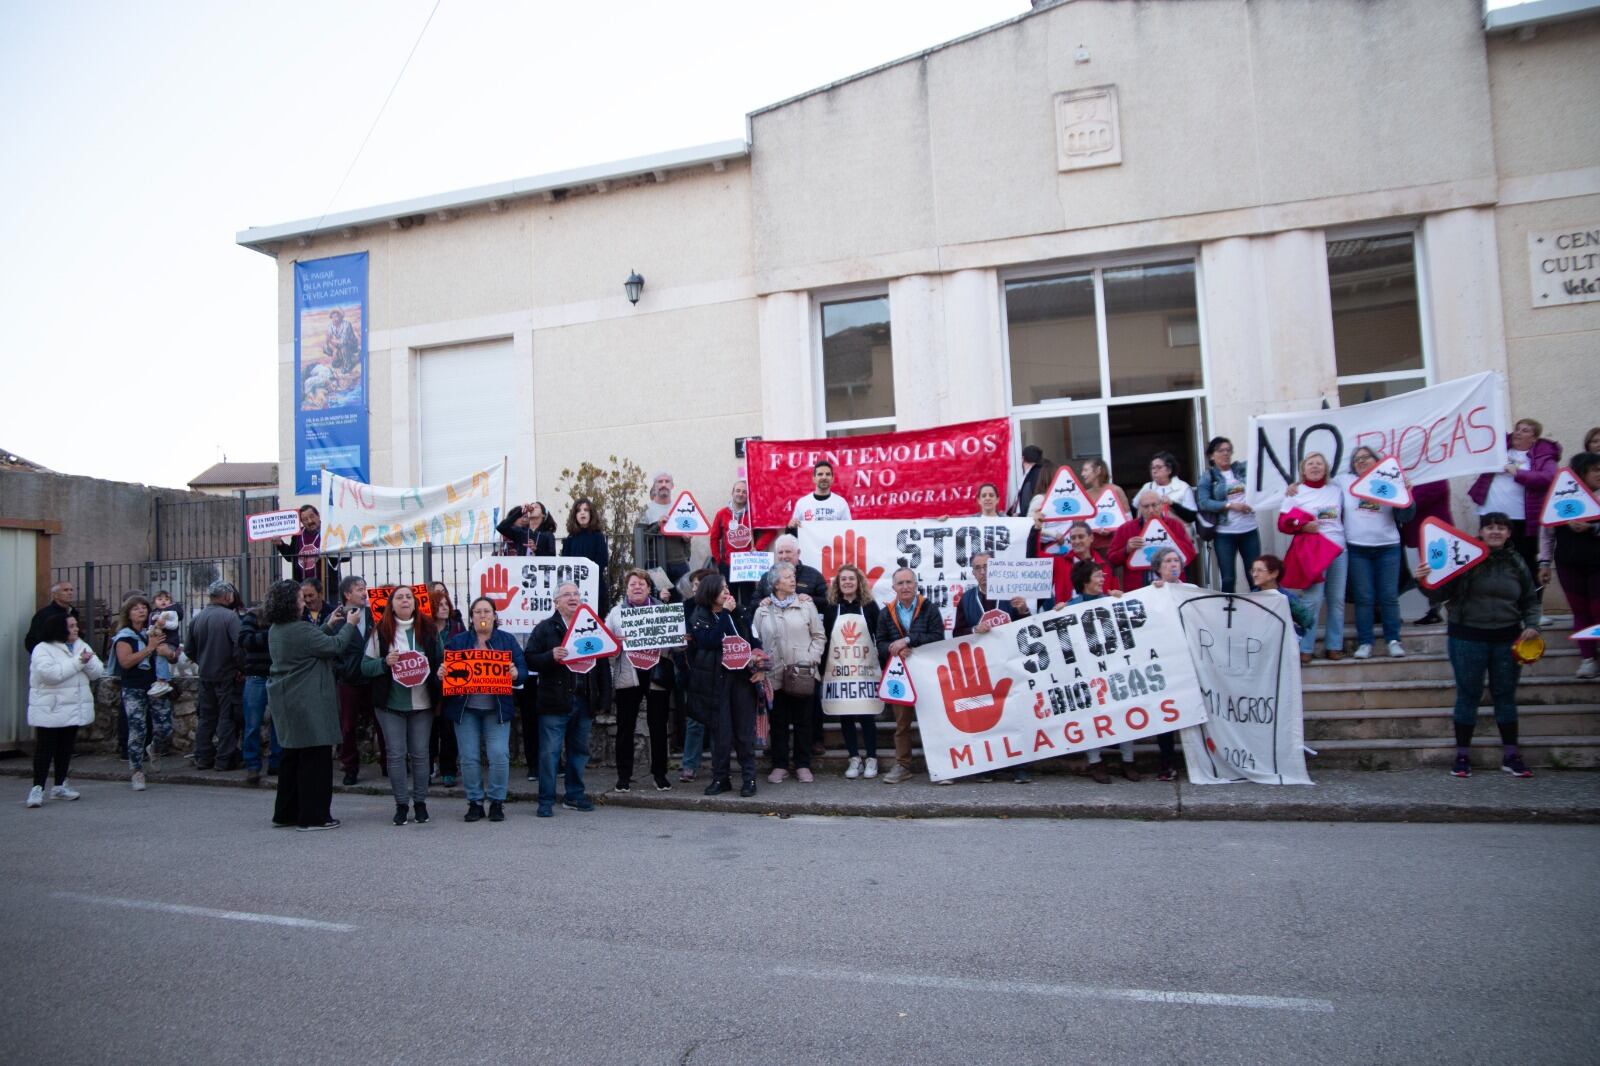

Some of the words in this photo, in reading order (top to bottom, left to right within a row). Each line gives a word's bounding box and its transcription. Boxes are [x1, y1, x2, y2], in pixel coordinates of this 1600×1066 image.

[322, 277, 352, 289] PINTURA
[312, 290, 328, 300] VELA
[330, 286, 360, 297] ZANETTI
[769, 434, 997, 470] FUENTEMOLINOS
[1257, 422, 1344, 492] NO
[855, 468, 896, 488] NO
[400, 487, 425, 510] A
[782, 499, 792, 512] A
[896, 525, 1010, 568] STOP
[522, 565, 589, 588] STOP
[986, 614, 1006, 628] TOP
[625, 630, 638, 638] LOS
[1016, 598, 1148, 674] STOP
[446, 652, 462, 661] SE
[464, 650, 510, 661] VENDE
[834, 646, 870, 660] STOP
[395, 657, 424, 672] STOP
[474, 662, 510, 676] STOP
[1028, 648, 1160, 690] PLANTA
[490, 686, 511, 694] ECHAN
[826, 682, 880, 699] MILAGROS
[950, 699, 1180, 769] MILAGROS
